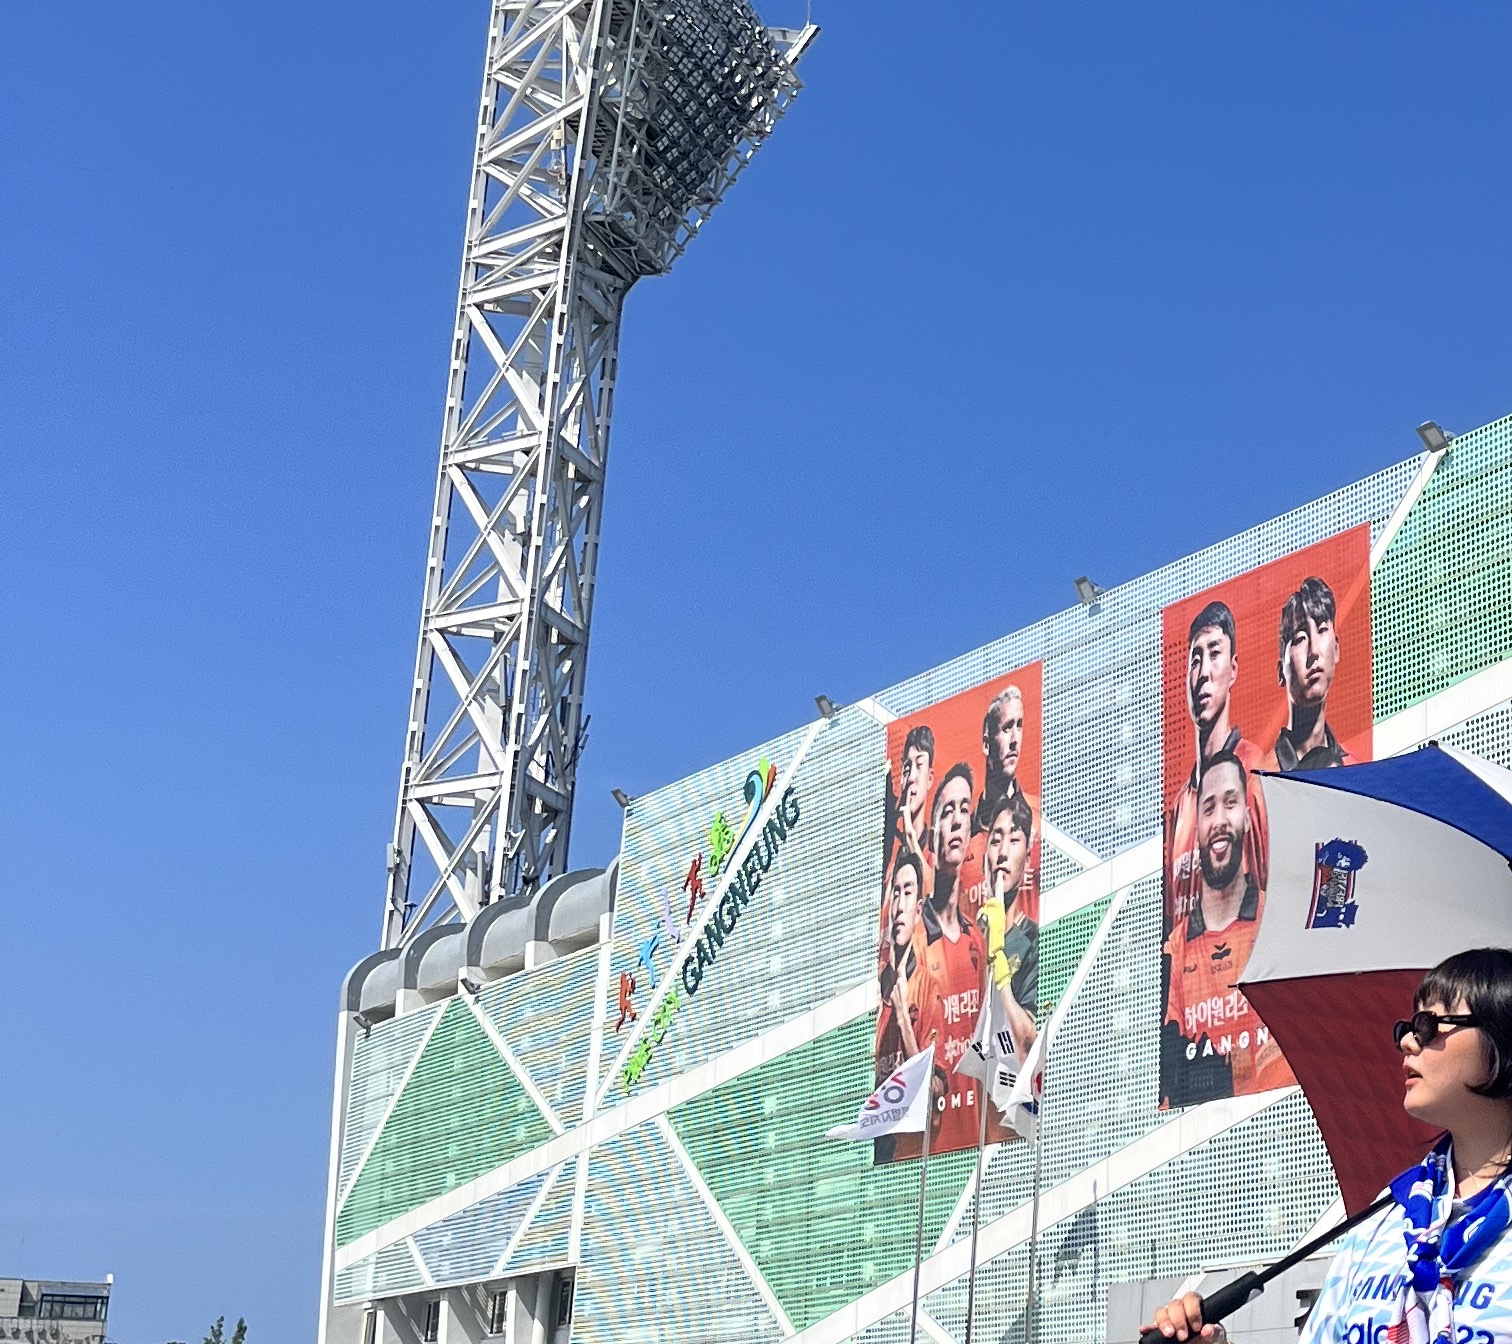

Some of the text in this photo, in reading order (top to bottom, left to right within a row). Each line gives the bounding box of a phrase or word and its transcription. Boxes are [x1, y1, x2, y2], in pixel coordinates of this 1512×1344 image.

[682, 786, 801, 996] GANGNEUNG
[1185, 1026, 1269, 1061] GANGN
[937, 1089, 974, 1112] OME
